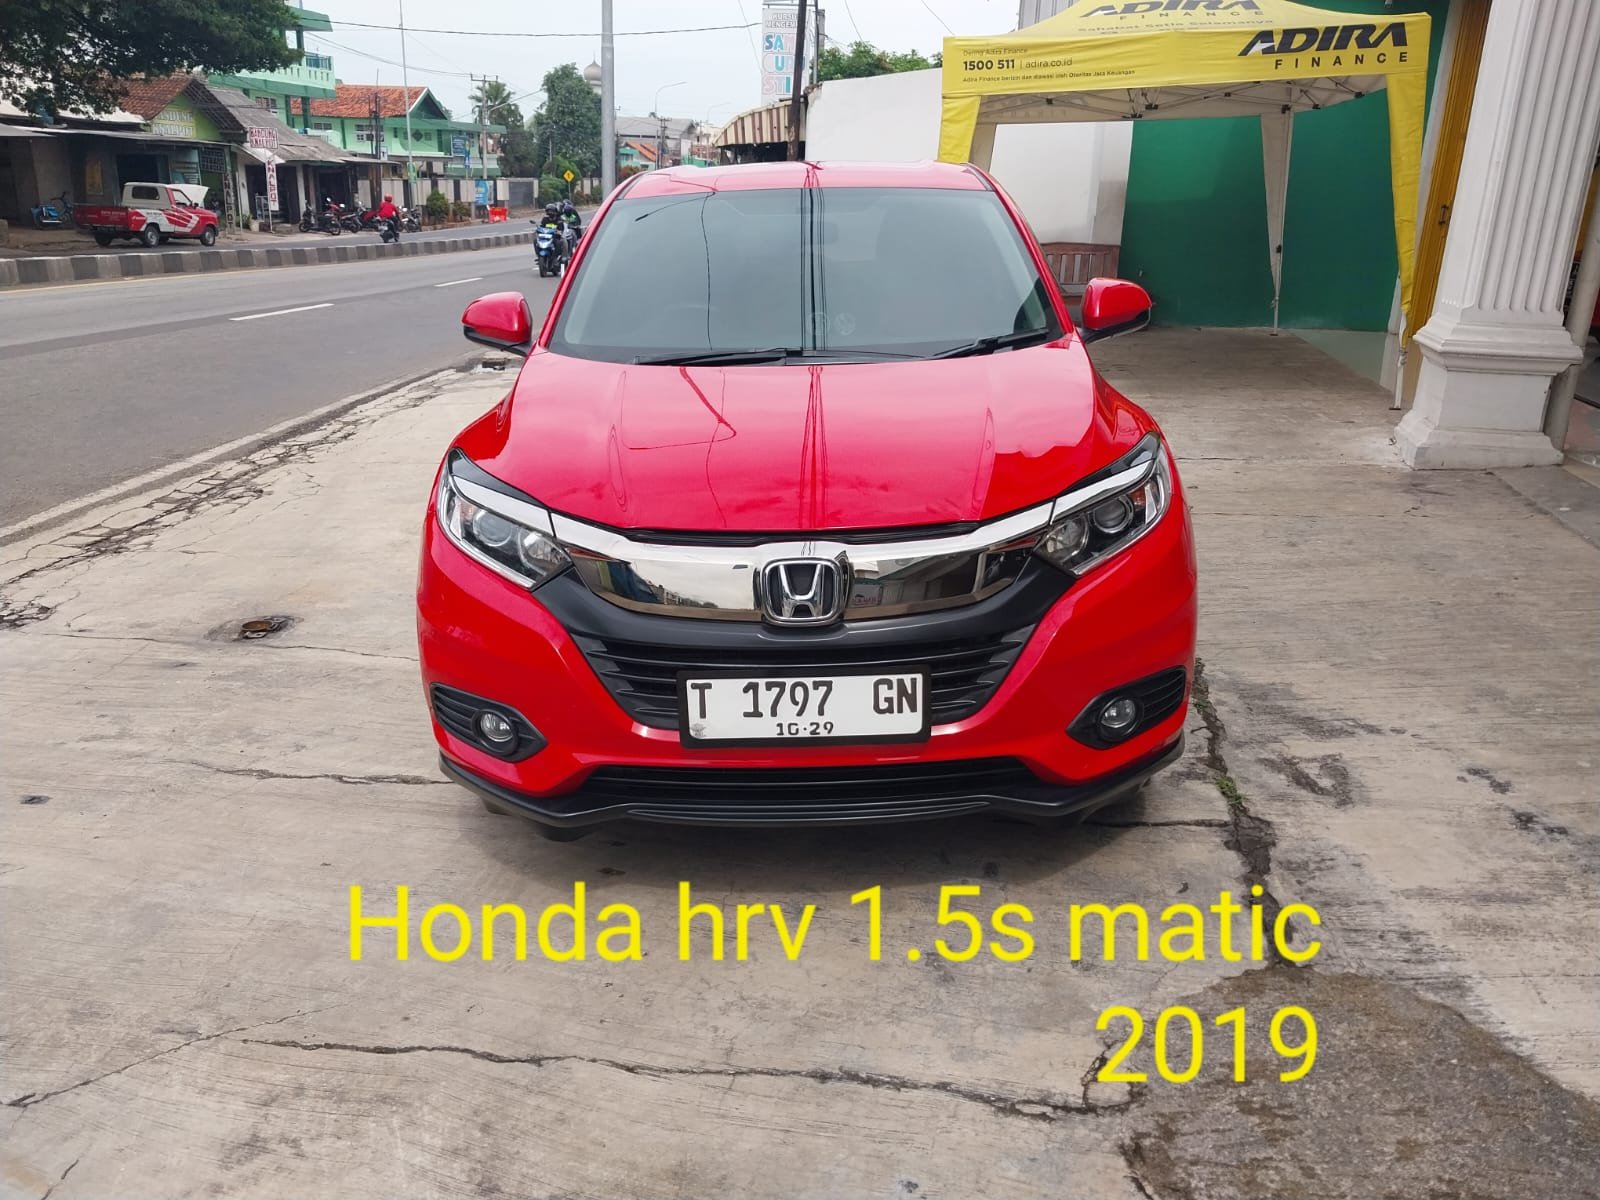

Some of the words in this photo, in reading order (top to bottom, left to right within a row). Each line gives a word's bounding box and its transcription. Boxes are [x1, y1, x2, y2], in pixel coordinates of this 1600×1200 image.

[1119, 11, 1265, 21] FINANCE
[1237, 22, 1409, 57] ADIRA
[963, 60, 994, 71] 1500
[997, 59, 1015, 70] 511
[1025, 57, 1073, 70] adira.co.id
[1274, 51, 1408, 71] FINANCE
[267, 160, 278, 208] KNALPOT
[690, 682, 713, 719] T
[742, 680, 834, 718] 1797
[872, 677, 918, 715] GN
